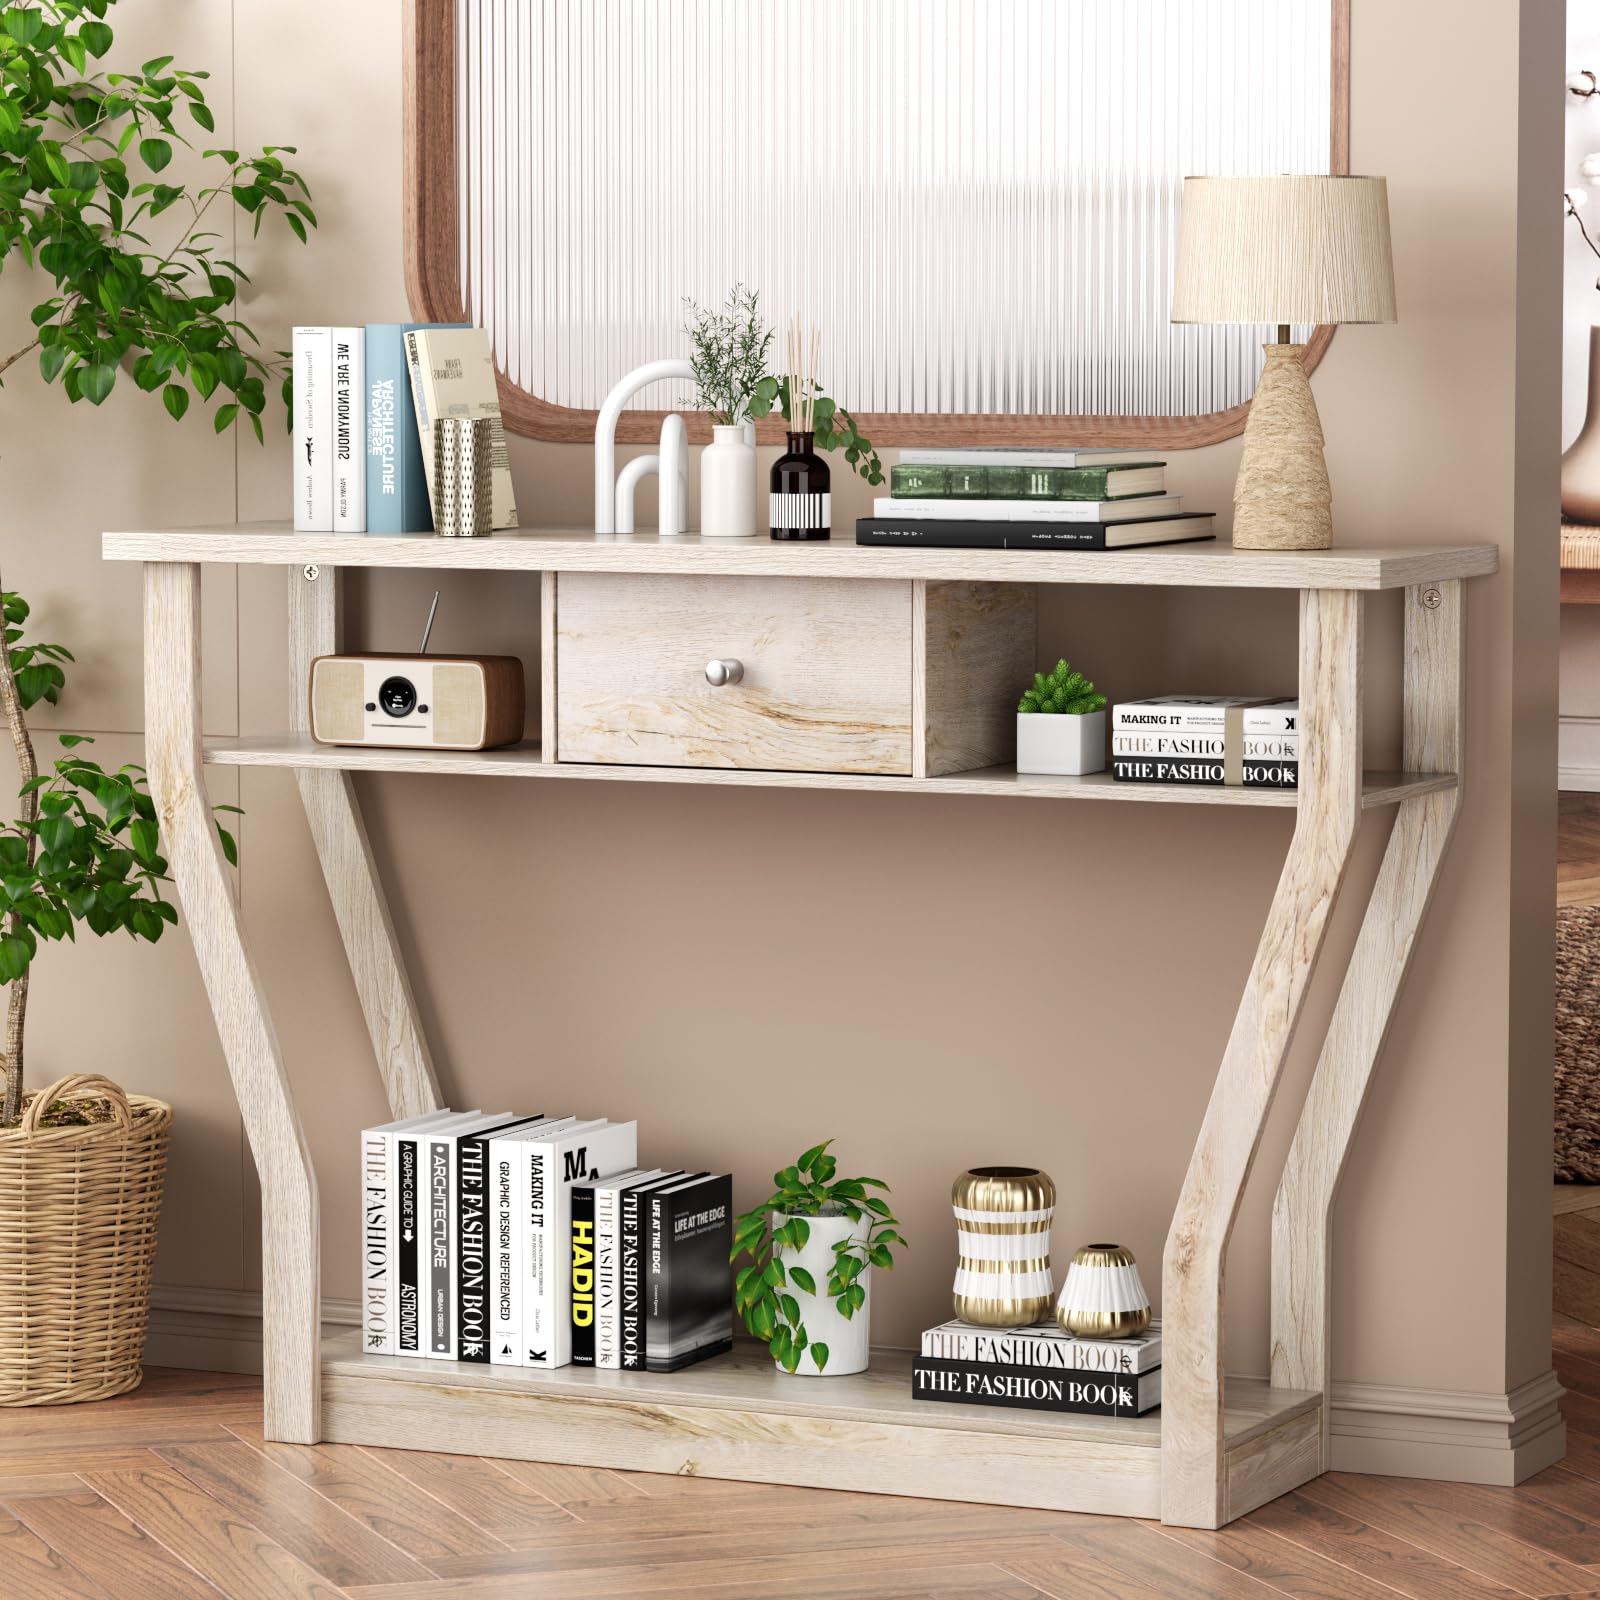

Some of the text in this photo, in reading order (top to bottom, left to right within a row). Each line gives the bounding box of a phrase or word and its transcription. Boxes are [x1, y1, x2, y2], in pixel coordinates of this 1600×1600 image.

[1121, 714, 1182, 725] MAKING IT
[1114, 737, 1295, 757] THE FASHIO BOOK
[1114, 762, 1296, 783] THE FASHIO BOOK
[403, 1152, 413, 1189] GRAPHIC
[500, 1161, 510, 1208] GRAPHIC
[404, 1190, 414, 1215] GUIDE
[531, 1155, 544, 1228] MAKING IT
[600, 1193, 612, 1228] THE
[404, 1216, 414, 1228] TO
[434, 1155, 447, 1268] ARCHITECTURE
[500, 1211, 510, 1250] DESIGN
[653, 1219, 660, 1230] AT
[674, 1206, 726, 1233] LIFE AT THE EDGE
[366, 1136, 387, 1348] THE FASHION BOOK
[462, 1142, 484, 1356] THE FASHION BOOK
[500, 1253, 510, 1321] REFERENCED
[572, 1220, 593, 1327] HADID
[600, 1233, 613, 1310] FASHION
[624, 1194, 638, 1366] THE FASHION BOOK
[401, 1283, 416, 1350] ASTRONOMY
[925, 1333, 968, 1361] THE
[975, 1336, 1066, 1368] FASHION
[914, 1369, 1134, 1407] THE FASHION BOOK
